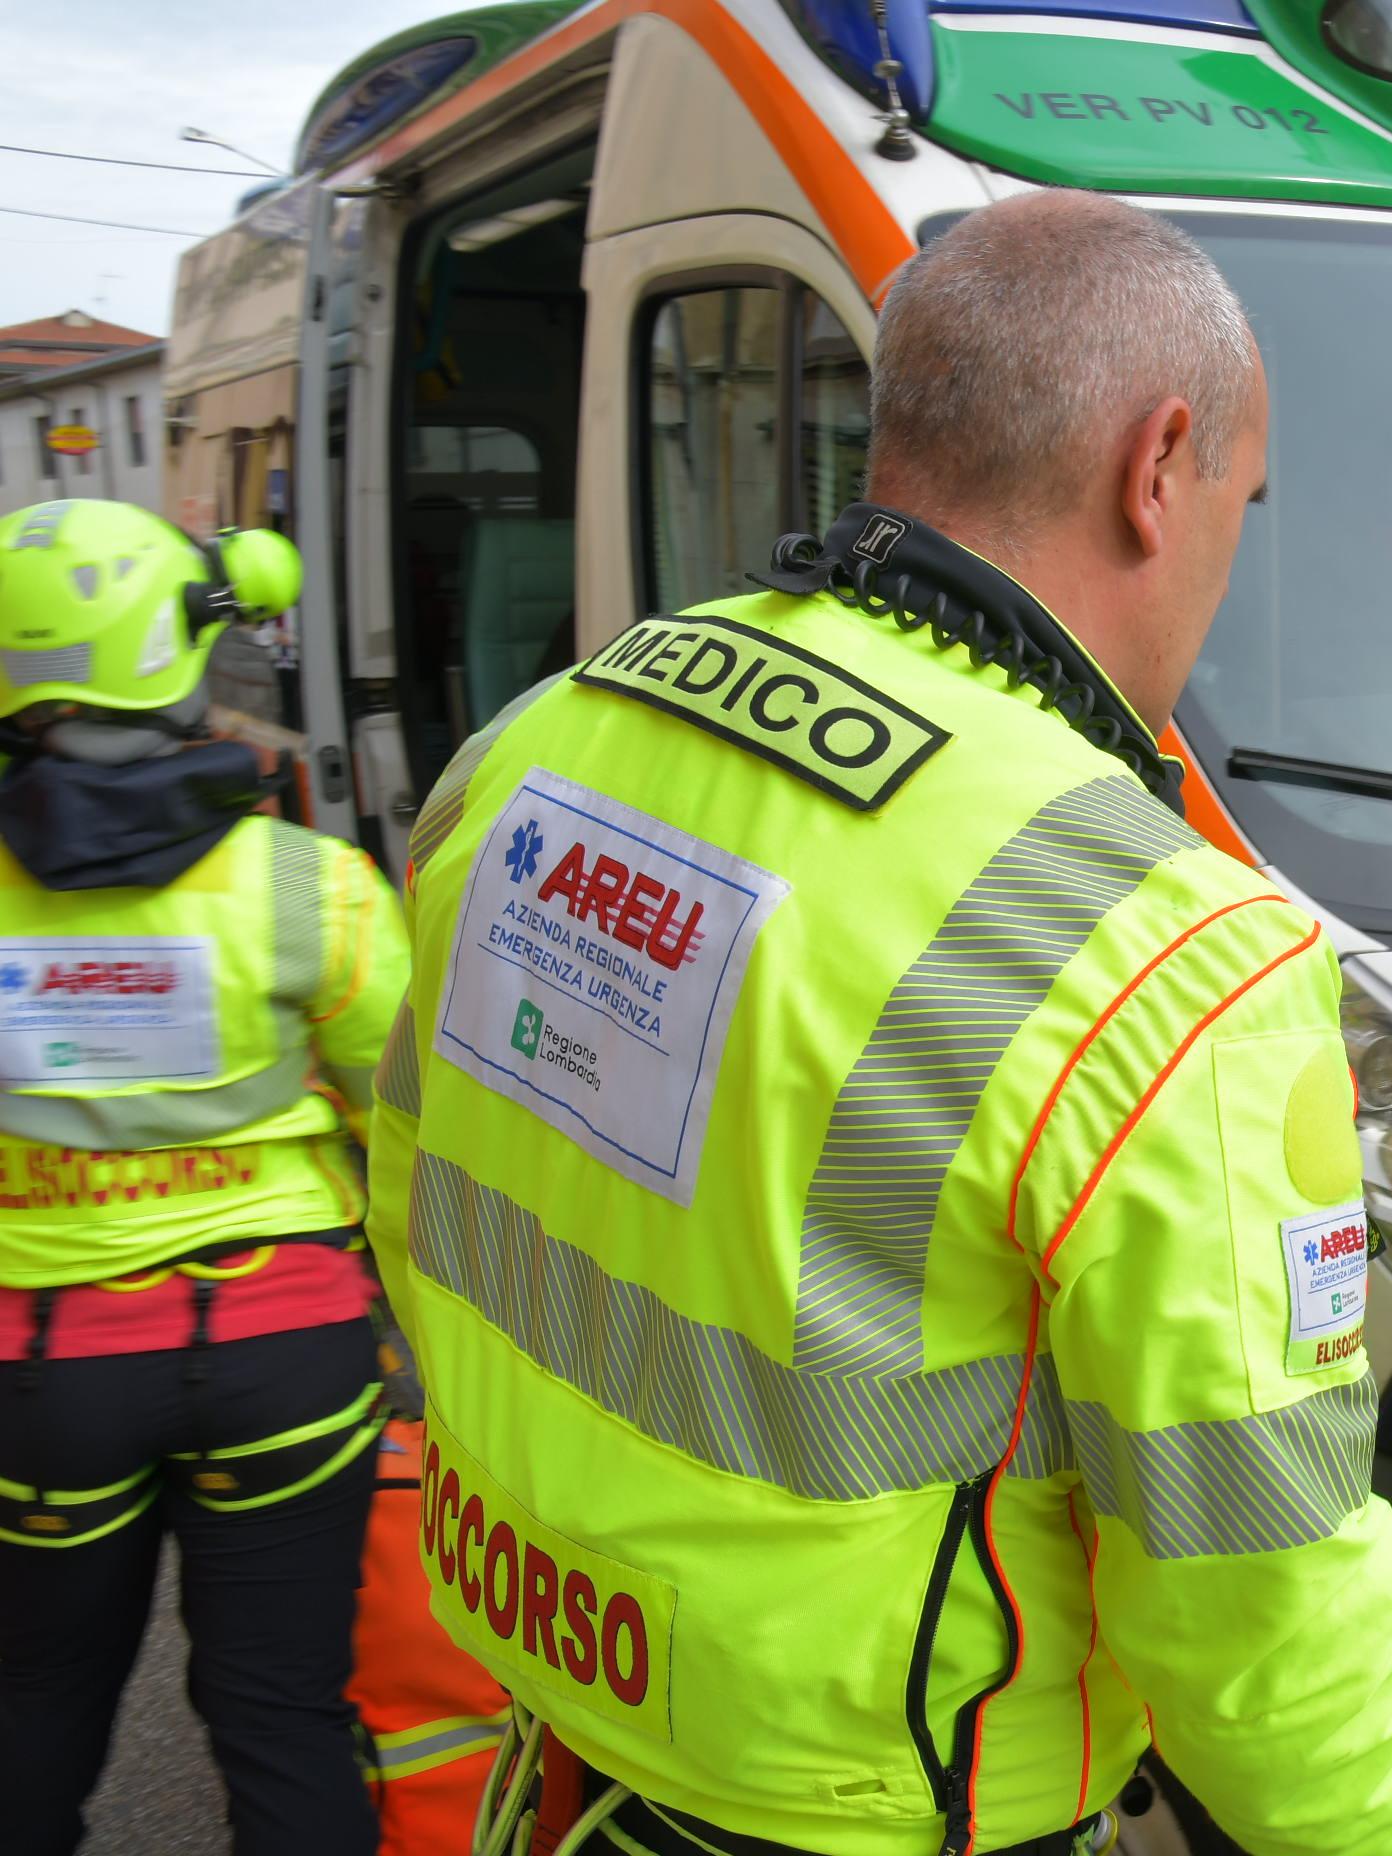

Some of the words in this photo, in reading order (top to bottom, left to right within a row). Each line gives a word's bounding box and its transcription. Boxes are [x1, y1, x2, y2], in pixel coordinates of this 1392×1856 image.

[992, 92, 1132, 121] VER
[1137, 96, 1214, 126] PV
[1231, 104, 1329, 134] 012
[602, 627, 892, 769] MEDICO
[537, 842, 705, 971] AREU
[488, 924, 583, 990] EMERGENZA
[587, 980, 661, 1037] URGENZA
[503, 899, 571, 949] AZIENDA
[575, 936, 668, 1002] REGIONALE
[540, 1046, 601, 1092] Lombardia
[543, 1024, 597, 1065] Regione
[1310, 1271, 1347, 1288] EMERGENZA
[1312, 1262, 1339, 1277] AZIENDA
[421, 1428, 649, 1706] OCCORSO
